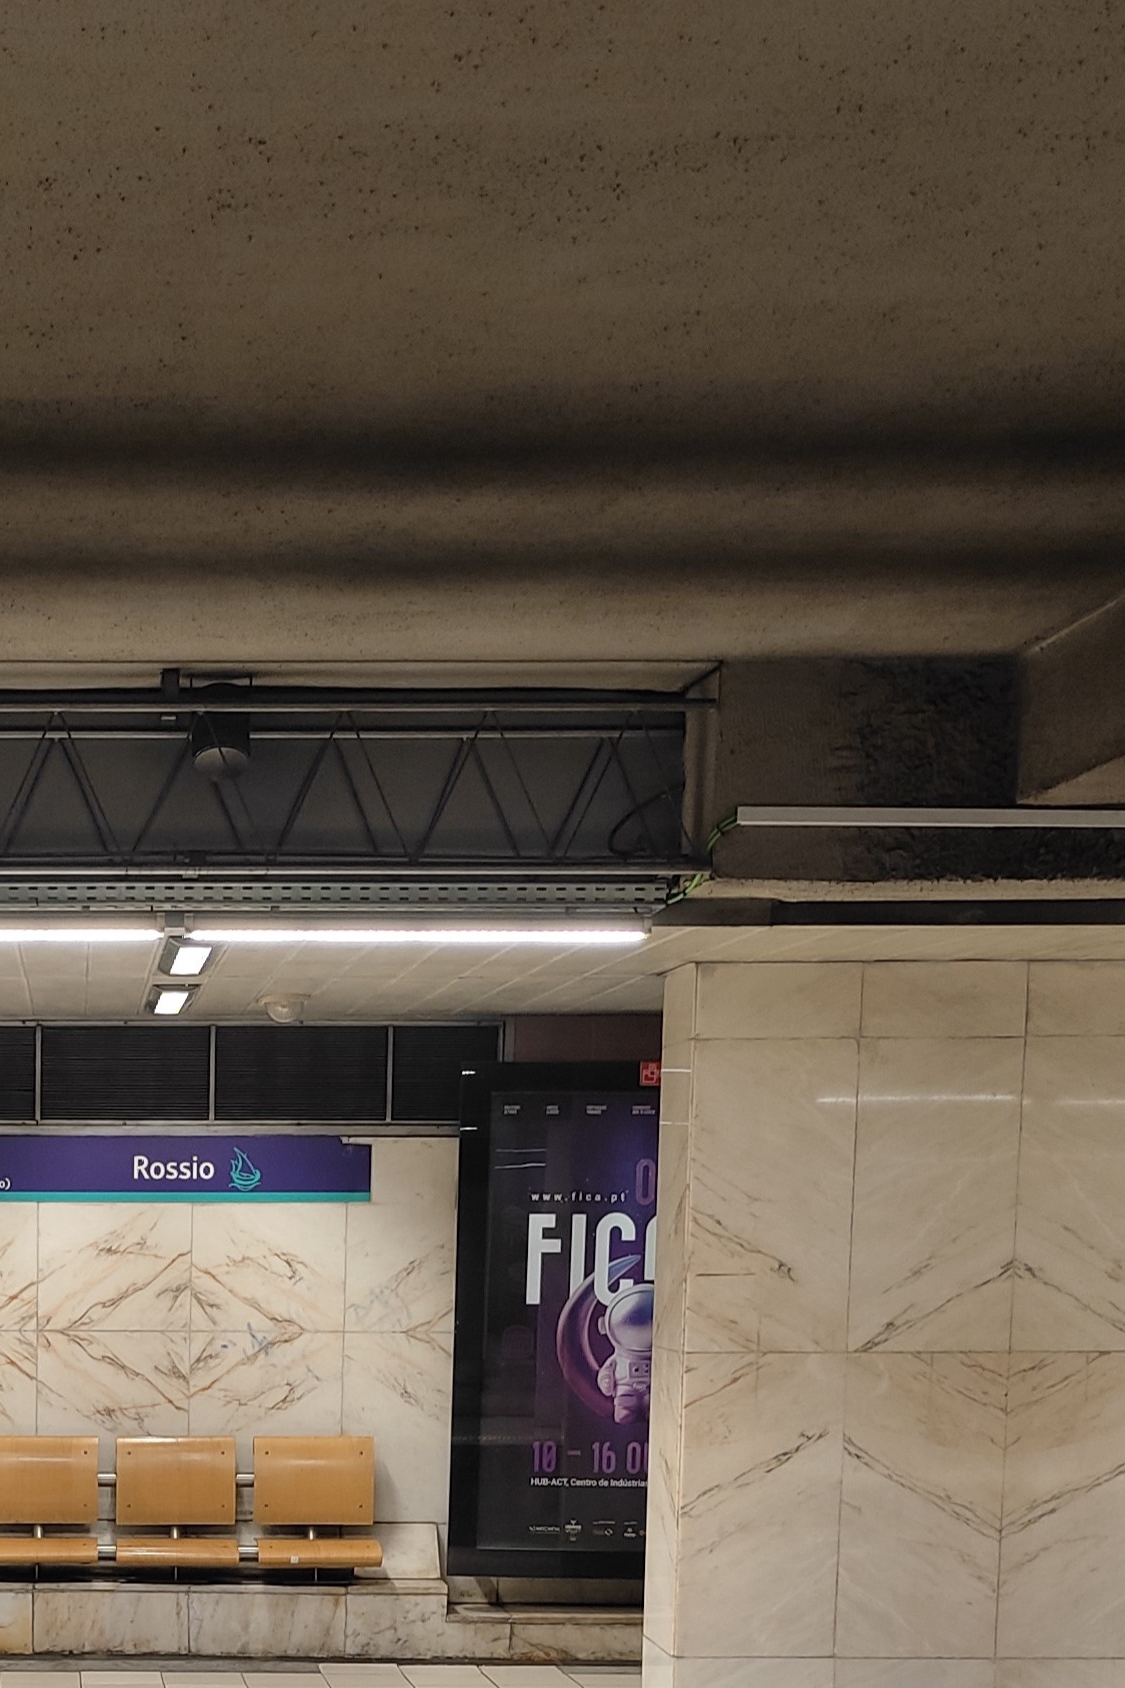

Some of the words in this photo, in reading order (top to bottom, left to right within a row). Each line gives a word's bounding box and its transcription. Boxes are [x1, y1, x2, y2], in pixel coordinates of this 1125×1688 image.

[133, 1155, 215, 1180] Rossio
[531, 1191, 625, 1203] www.fica.pt
[526, 1212, 658, 1306] FIC
[532, 1441, 557, 1473] 10
[592, 1441, 616, 1474] 16
[530, 1477, 569, 1488] HUB-ACT,
[570, 1478, 597, 1487] Centro
[598, 1479, 609, 1487] de
